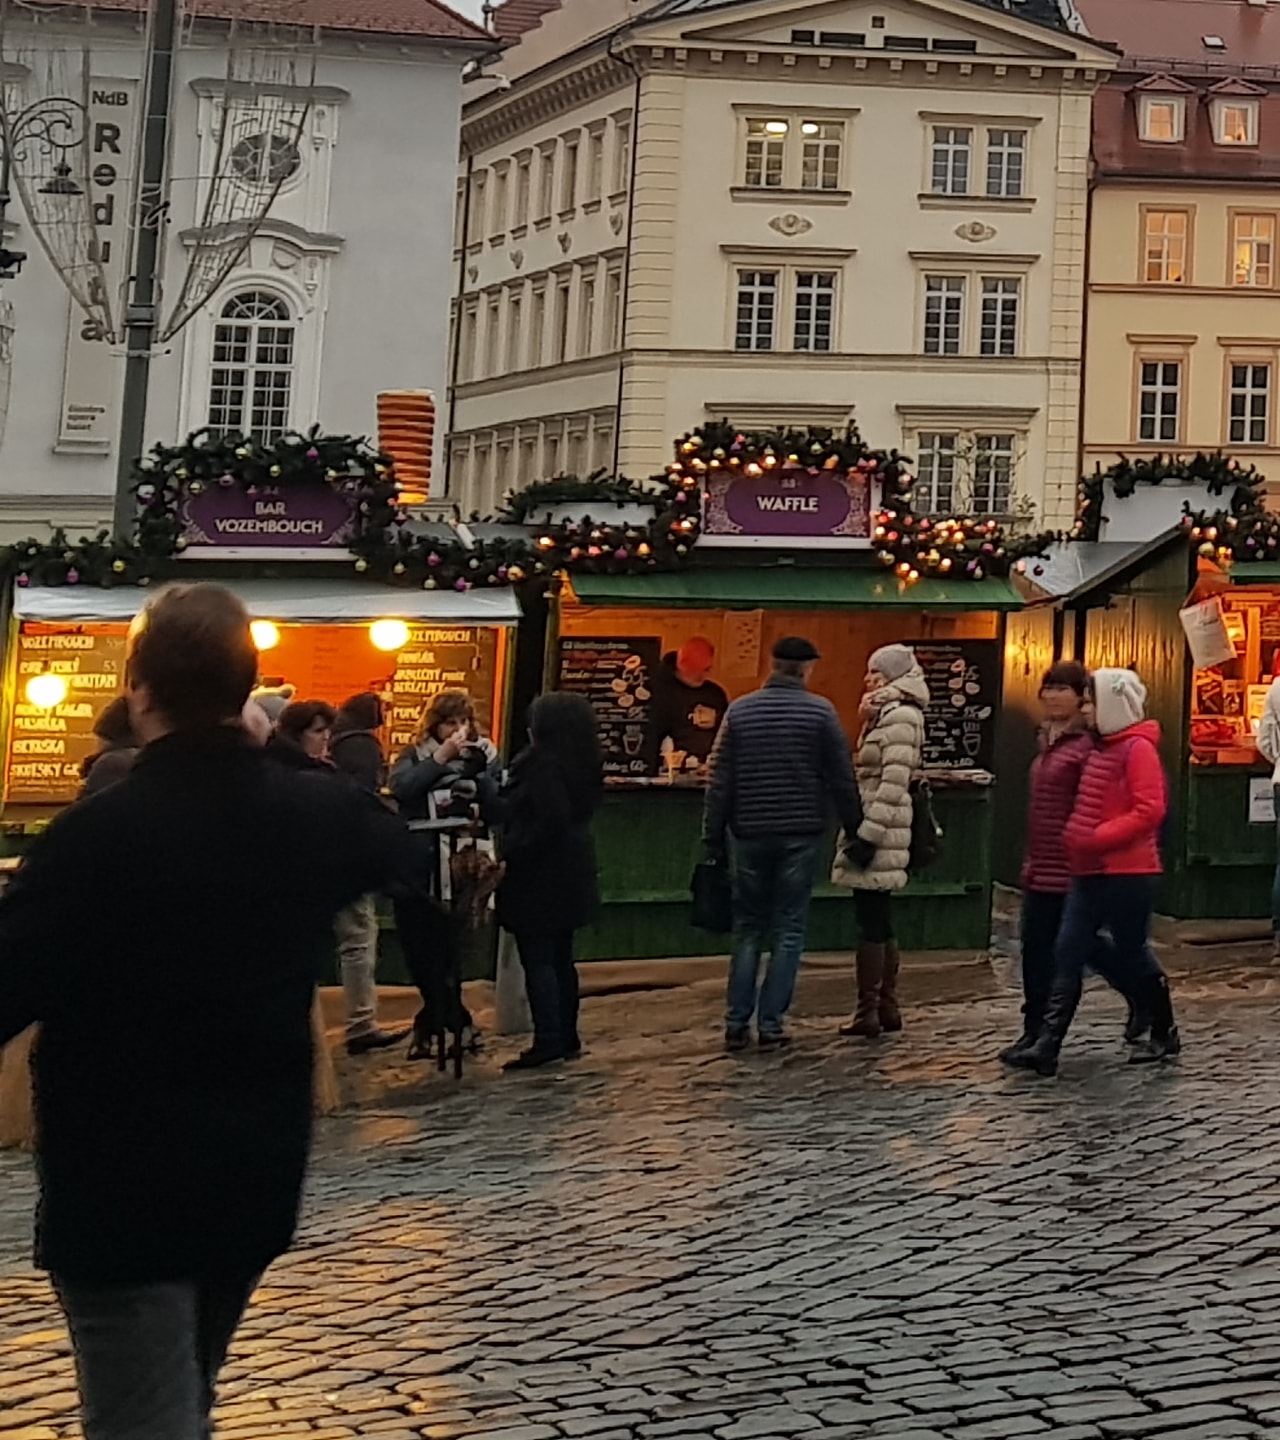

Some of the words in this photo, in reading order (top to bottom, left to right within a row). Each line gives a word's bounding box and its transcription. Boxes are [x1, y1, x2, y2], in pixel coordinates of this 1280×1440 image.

[92, 90, 128, 106] NdB
[255, 501, 286, 515] BAR
[756, 496, 818, 512] WAFFLE
[214, 518, 323, 533] VOZEMBOUCH
